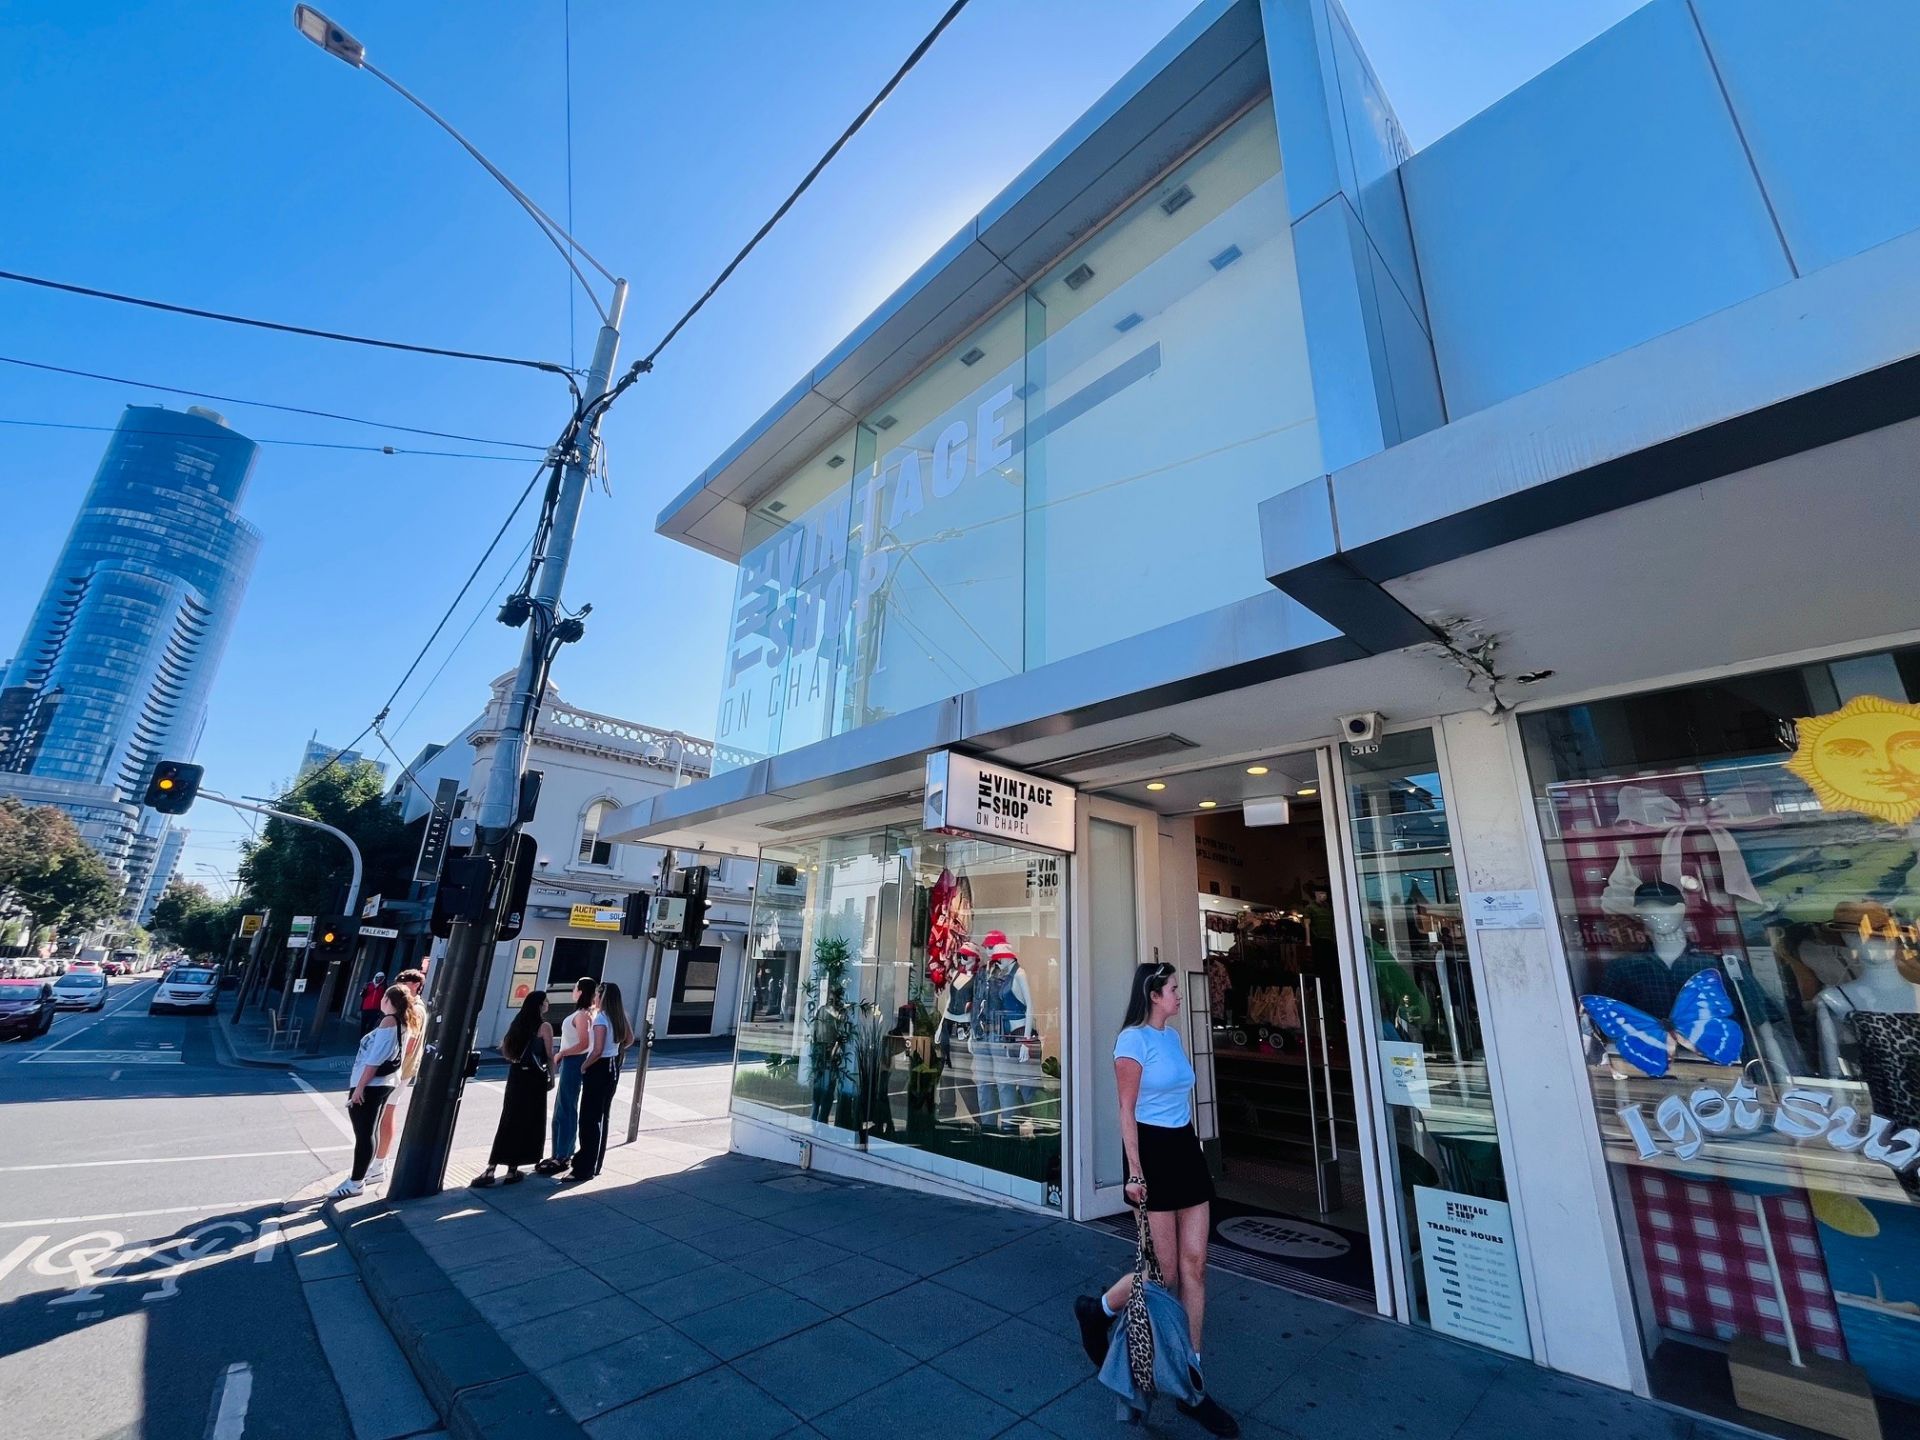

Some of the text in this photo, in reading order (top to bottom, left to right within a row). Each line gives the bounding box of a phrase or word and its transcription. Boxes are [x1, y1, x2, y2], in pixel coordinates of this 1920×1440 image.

[777, 383, 1014, 593] VINTAGE
[728, 550, 777, 689] THE
[765, 548, 890, 669] SHOP
[720, 688, 752, 738] ON
[978, 770, 992, 810] THE
[994, 774, 1052, 806] VINTAGE
[992, 795, 1028, 820] SHOP
[425, 801, 446, 858] IMPERIAL
[976, 811, 1029, 836] ON CHAPEL
[1026, 860, 1036, 888] THE
[1038, 858, 1060, 872] VIN
[609, 912, 624, 920] SOL
[361, 928, 389, 936] PALERMO
[1454, 1202, 1489, 1217] VINTAGE
[1455, 1210, 1475, 1220] SHOP
[1426, 1221, 1468, 1236] TRADING
[1470, 1231, 1504, 1245] HOURS
